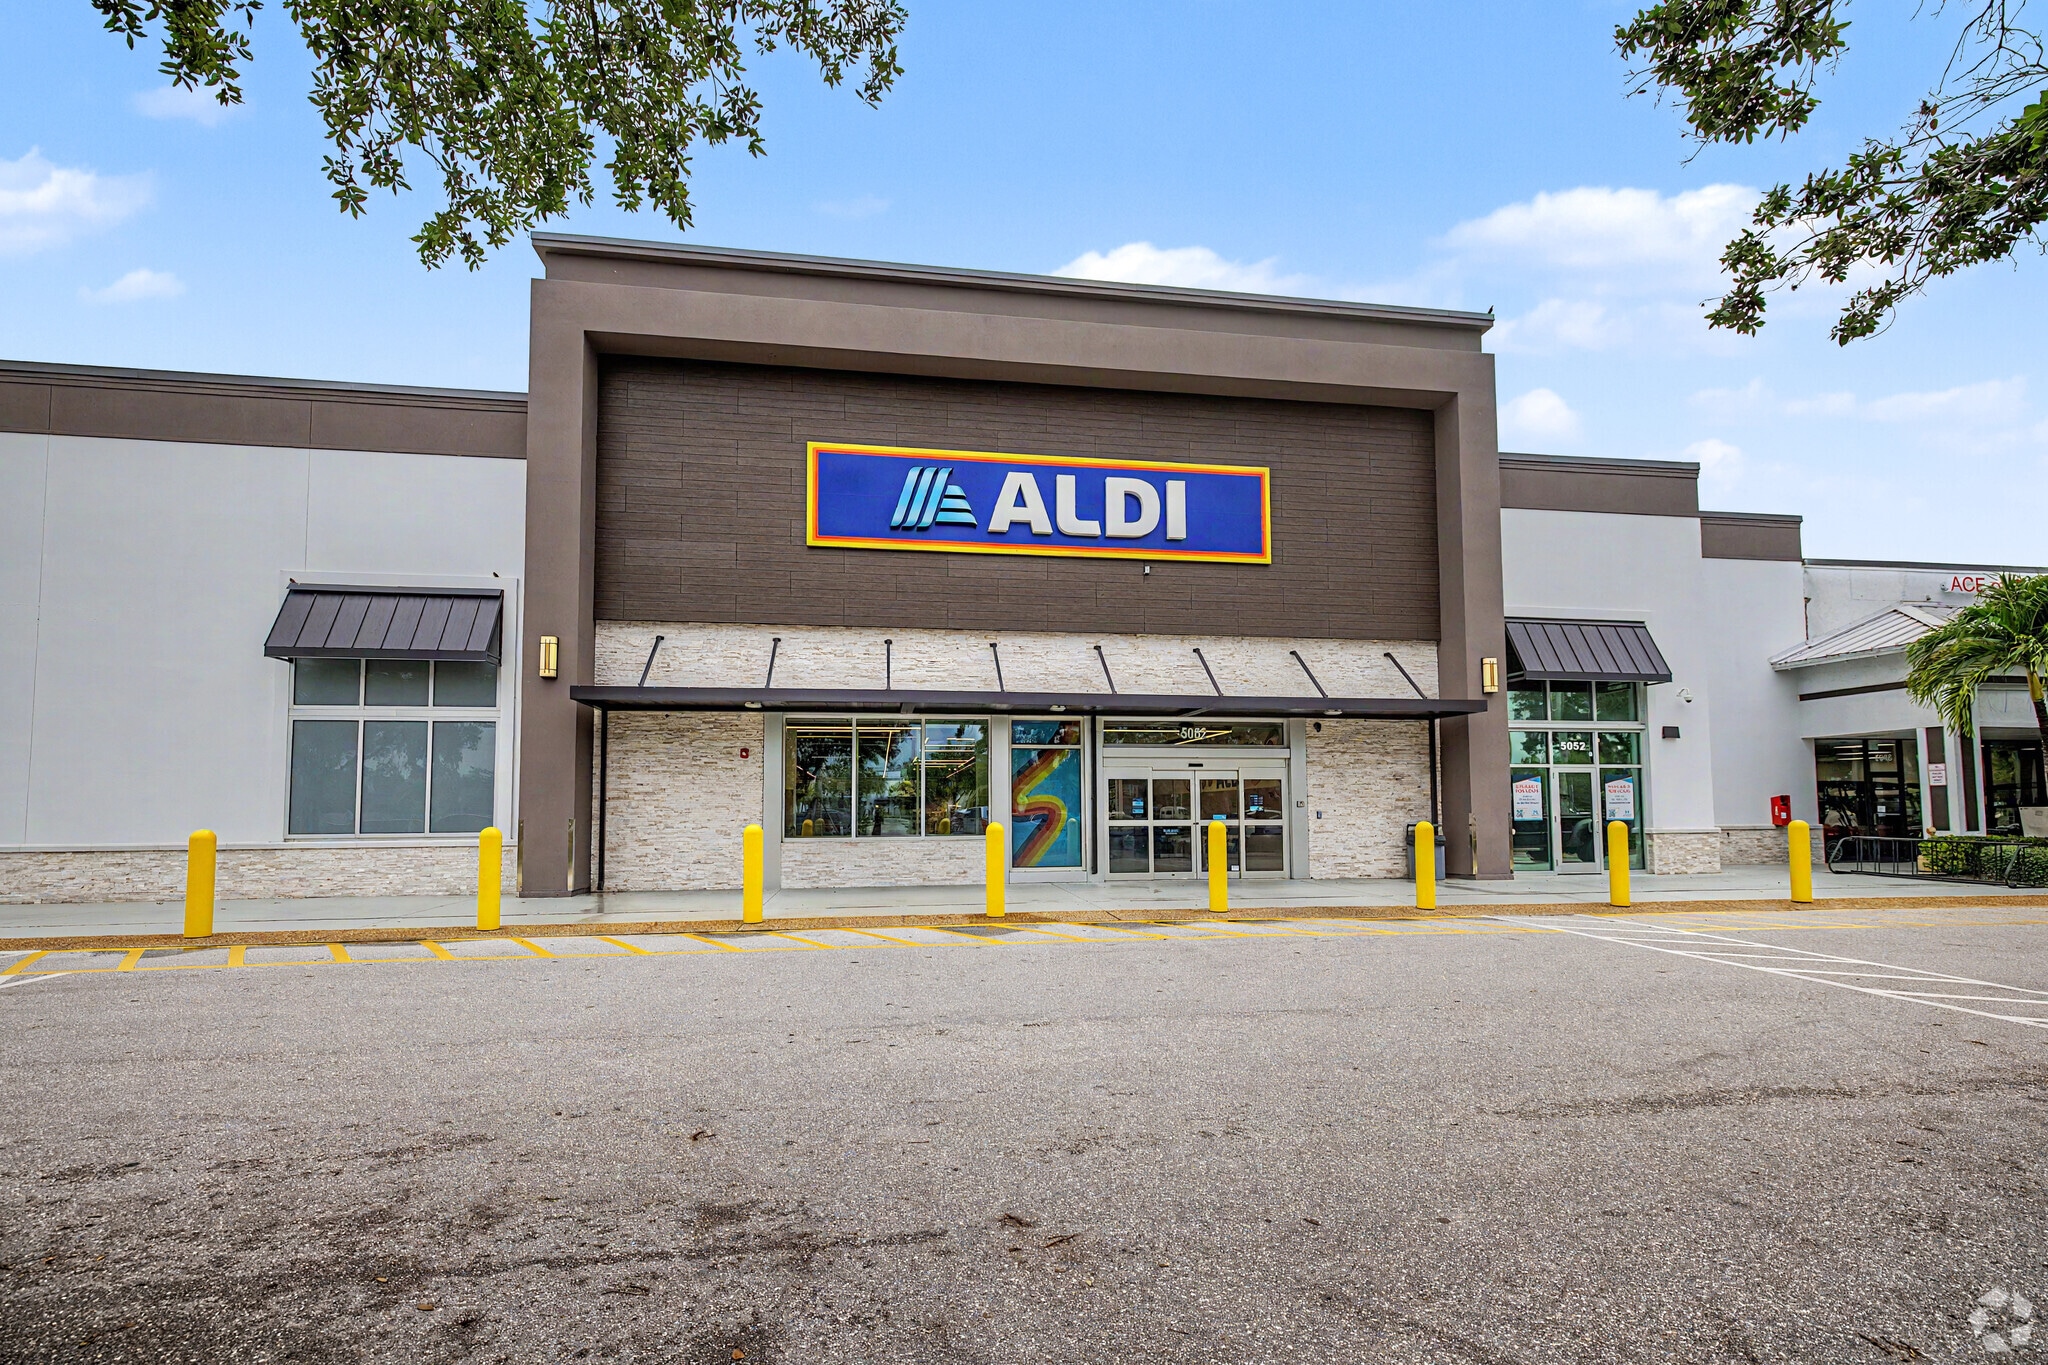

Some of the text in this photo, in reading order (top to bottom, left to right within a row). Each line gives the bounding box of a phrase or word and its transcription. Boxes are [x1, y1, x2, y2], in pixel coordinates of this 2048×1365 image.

[987, 471, 1187, 540] ALDI
[1950, 576, 1985, 592] ACE
[1560, 741, 1586, 751] 5052
